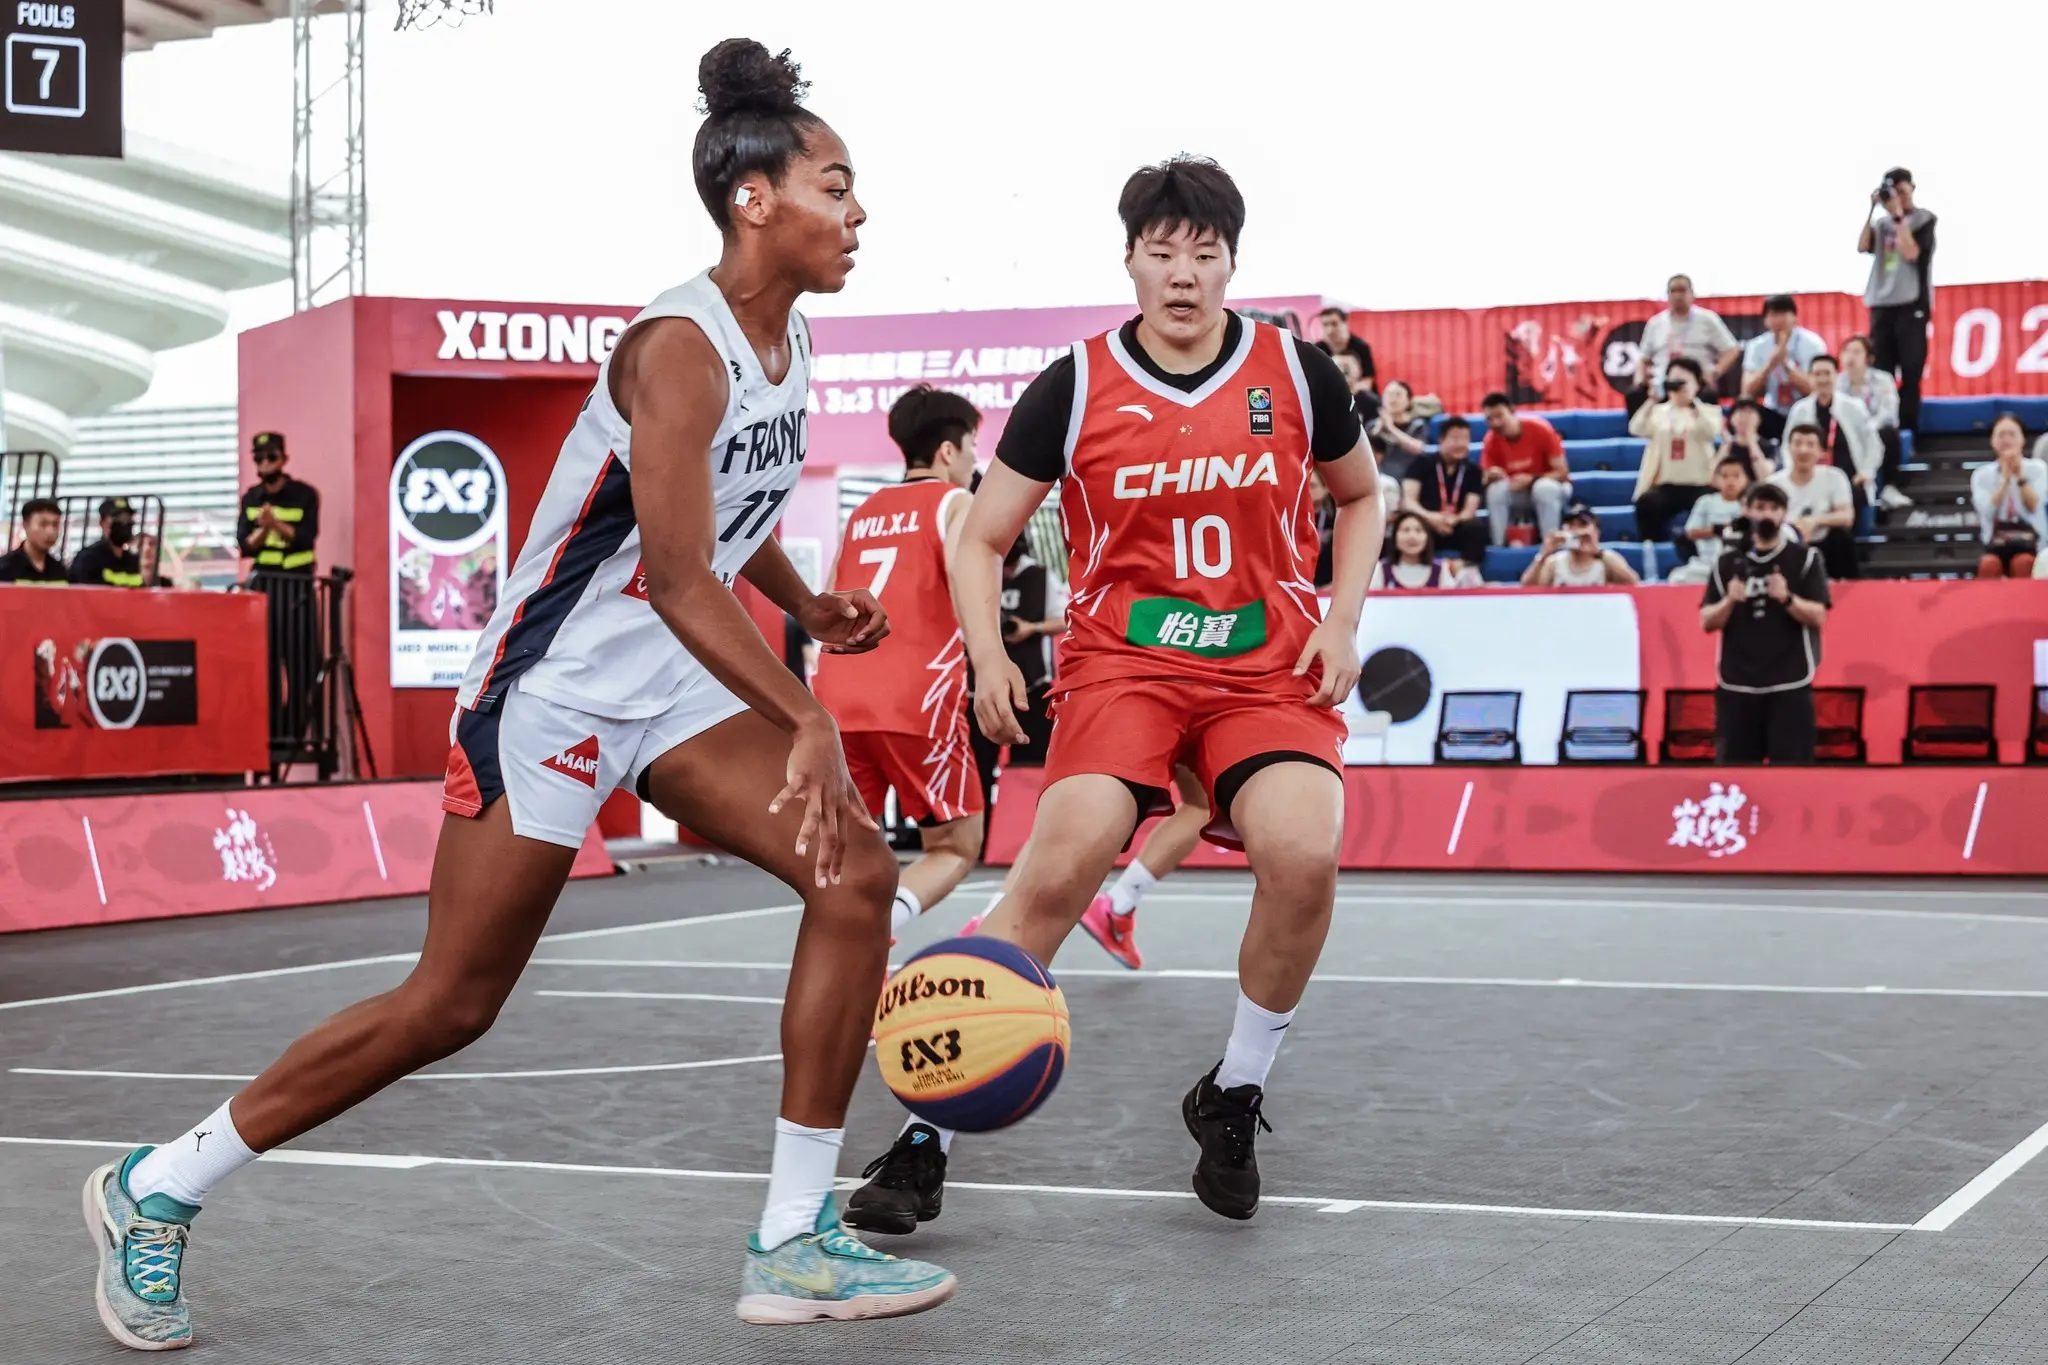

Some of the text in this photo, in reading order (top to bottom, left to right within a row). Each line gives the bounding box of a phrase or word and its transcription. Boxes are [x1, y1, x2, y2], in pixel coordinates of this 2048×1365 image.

[17, 1, 75, 29] FOULS
[32, 47, 60, 99] 7
[436, 310, 628, 364] XIONG
[1252, 414, 1270, 423] FIBA
[1113, 452, 1279, 499] CHINA
[851, 510, 919, 542] WU.X.L
[1172, 514, 1232, 578] 10
[859, 546, 898, 600] 7
[1156, 611, 1238, 649] 怡寶
